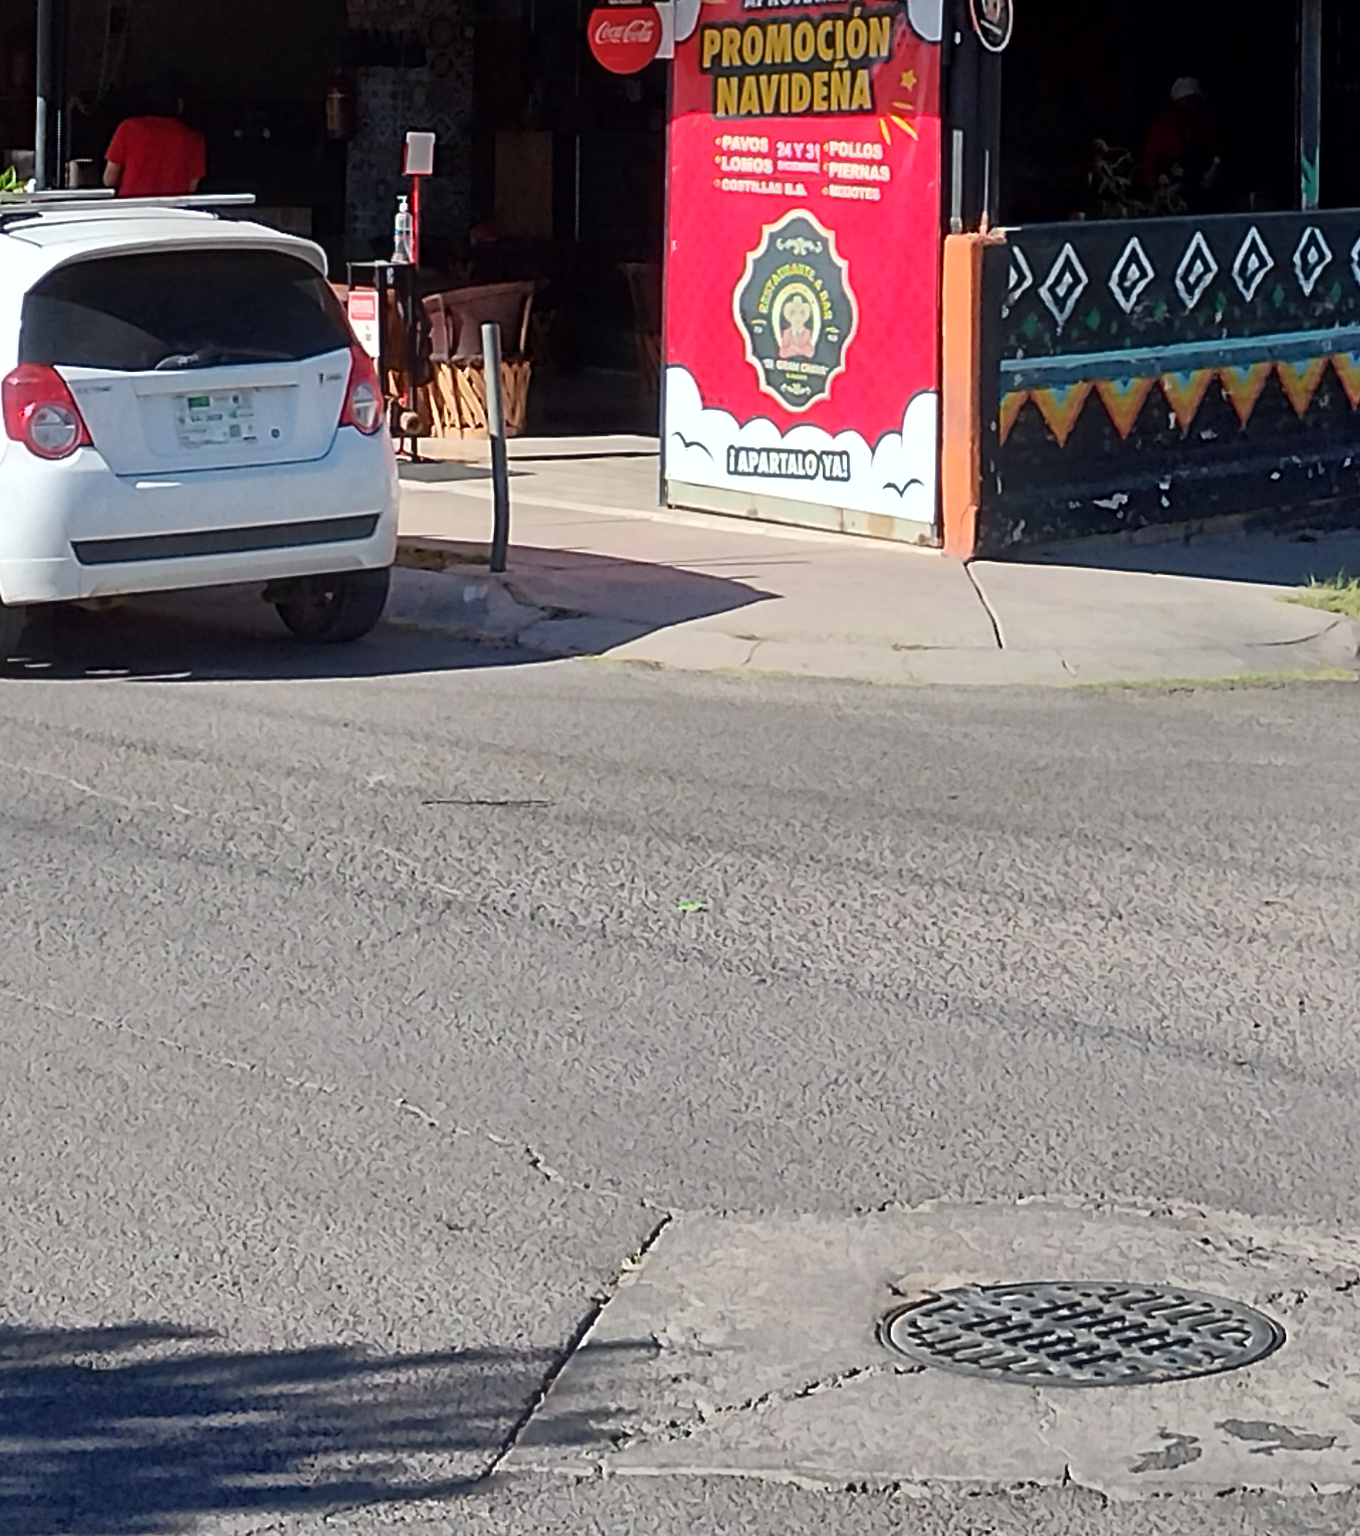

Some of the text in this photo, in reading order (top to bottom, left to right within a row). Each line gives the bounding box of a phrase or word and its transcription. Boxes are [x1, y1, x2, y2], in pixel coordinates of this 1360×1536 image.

[702, 6, 891, 69] PROMOCIÓN
[715, 60, 873, 117] NAVIDEÑA
[722, 135, 770, 153] PAVOS
[793, 142, 805, 159] Y
[829, 141, 883, 160] POLLOS
[720, 155, 774, 175] LOMOS
[828, 162, 892, 183] PIERNAS
[821, 453, 850, 479] YA!
